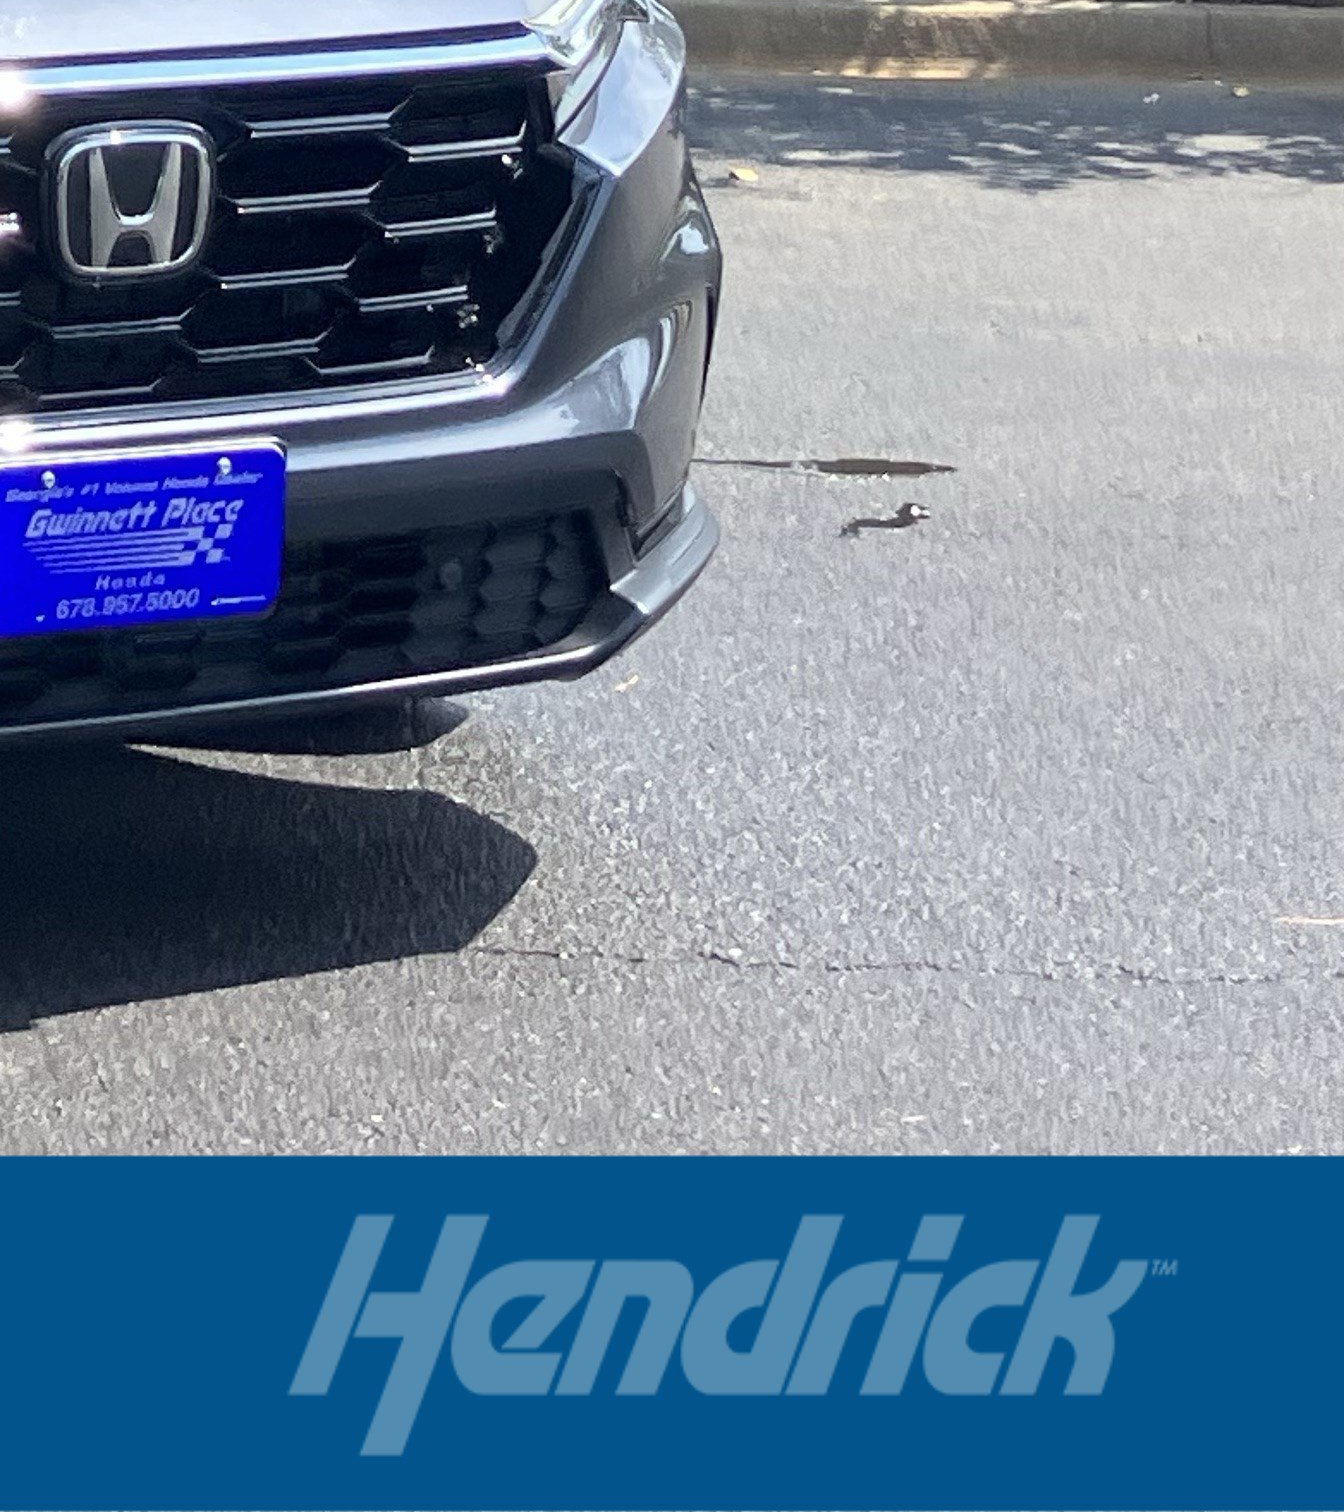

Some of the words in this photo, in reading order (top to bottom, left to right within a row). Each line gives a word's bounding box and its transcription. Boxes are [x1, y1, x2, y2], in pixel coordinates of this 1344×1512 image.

[25, 500, 157, 538] Gwinnett
[161, 497, 244, 527] Place
[95, 571, 166, 590] Honda
